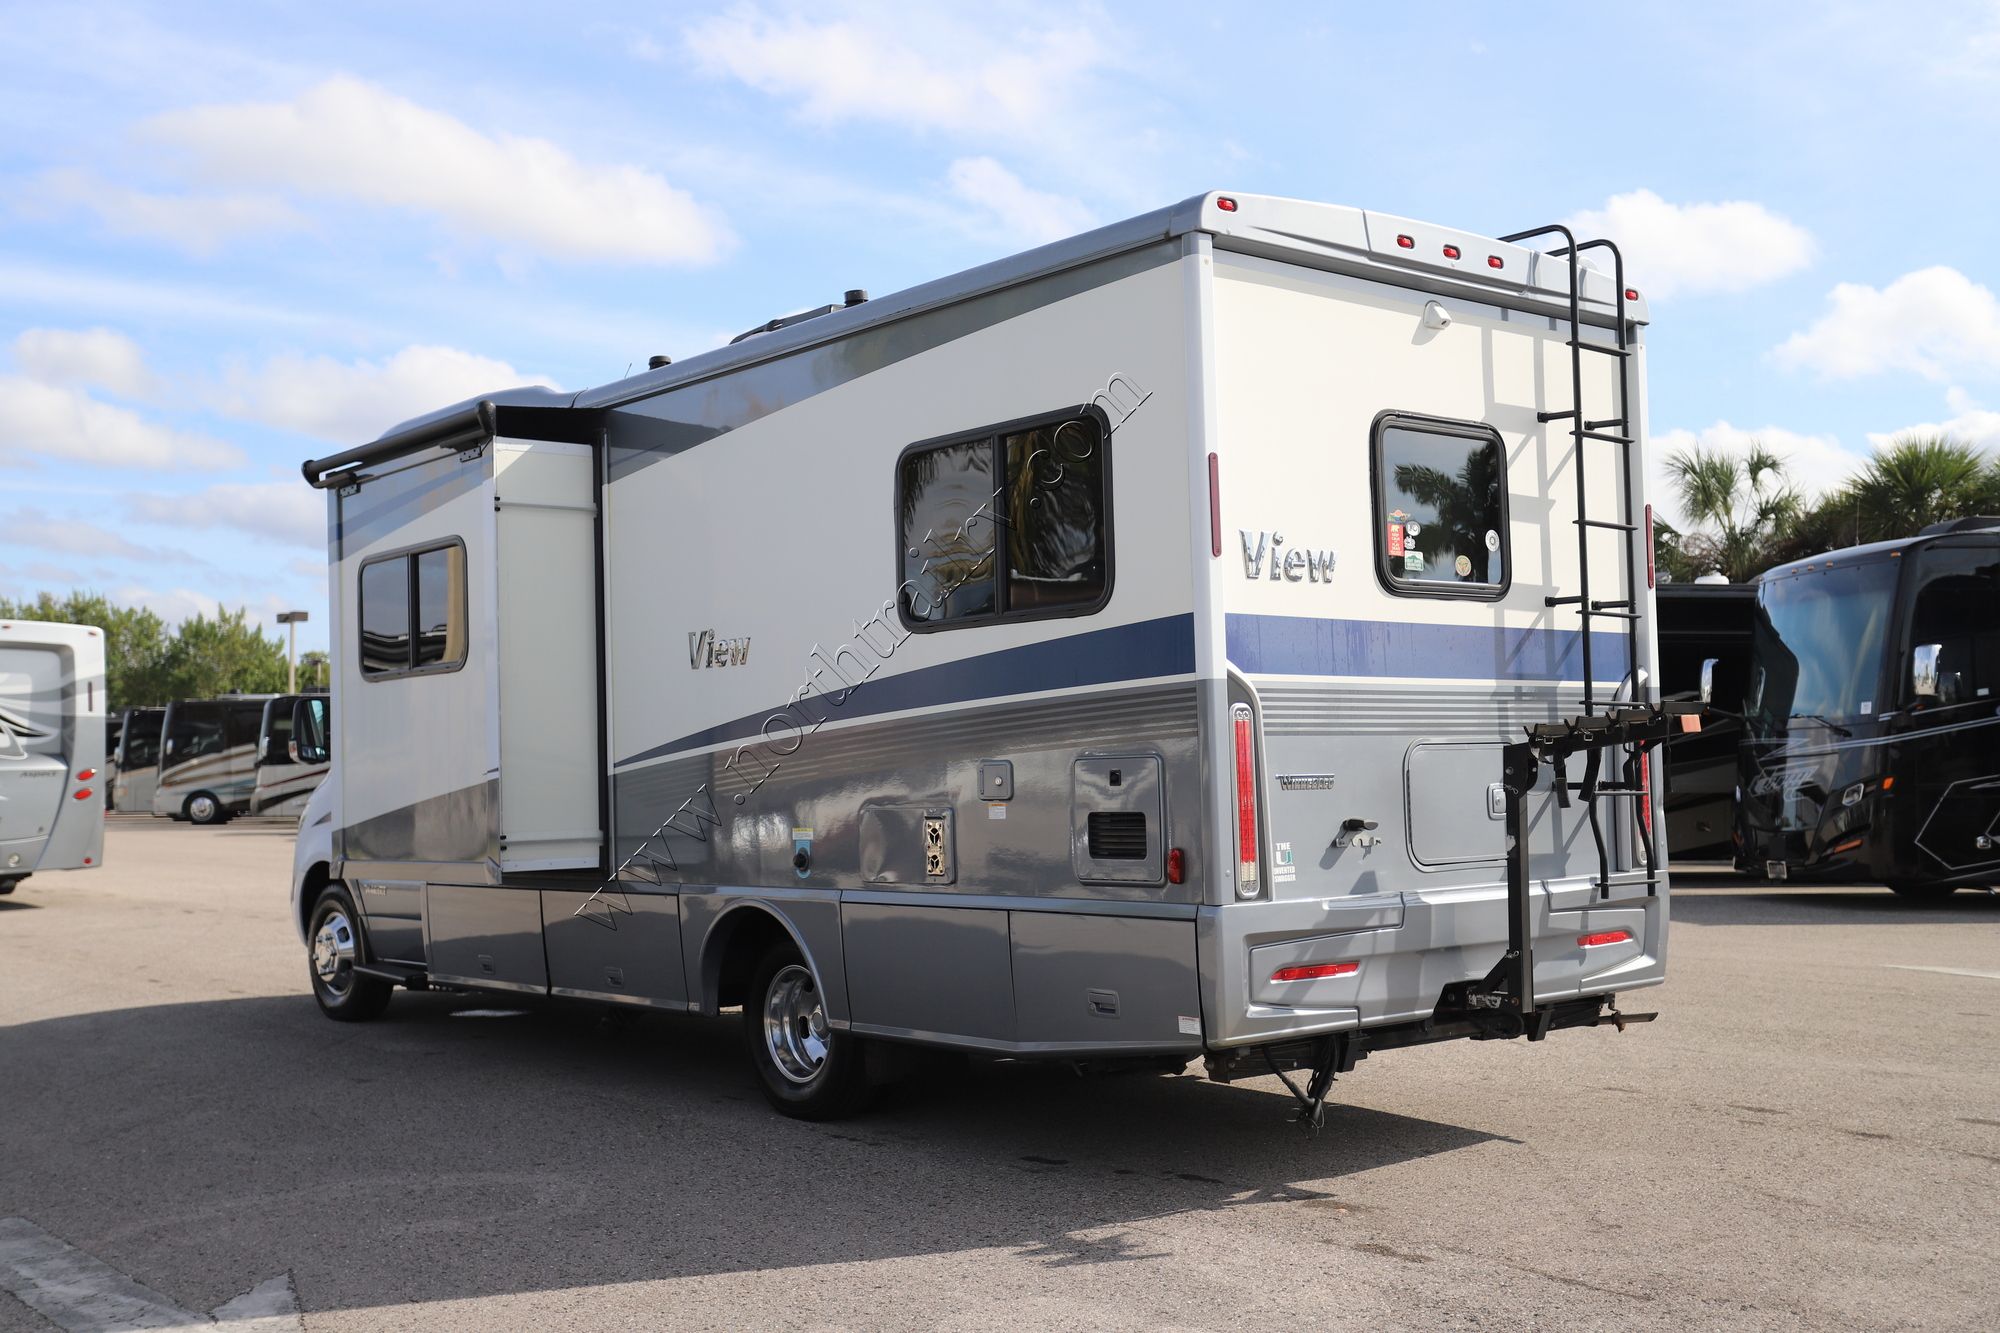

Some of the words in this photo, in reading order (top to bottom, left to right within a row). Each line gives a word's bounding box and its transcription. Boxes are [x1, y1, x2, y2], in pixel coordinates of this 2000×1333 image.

[1238, 528, 1338, 584] View
[688, 628, 751, 670] View
[1275, 842, 1291, 851] THE
[1275, 850, 1294, 866] U
